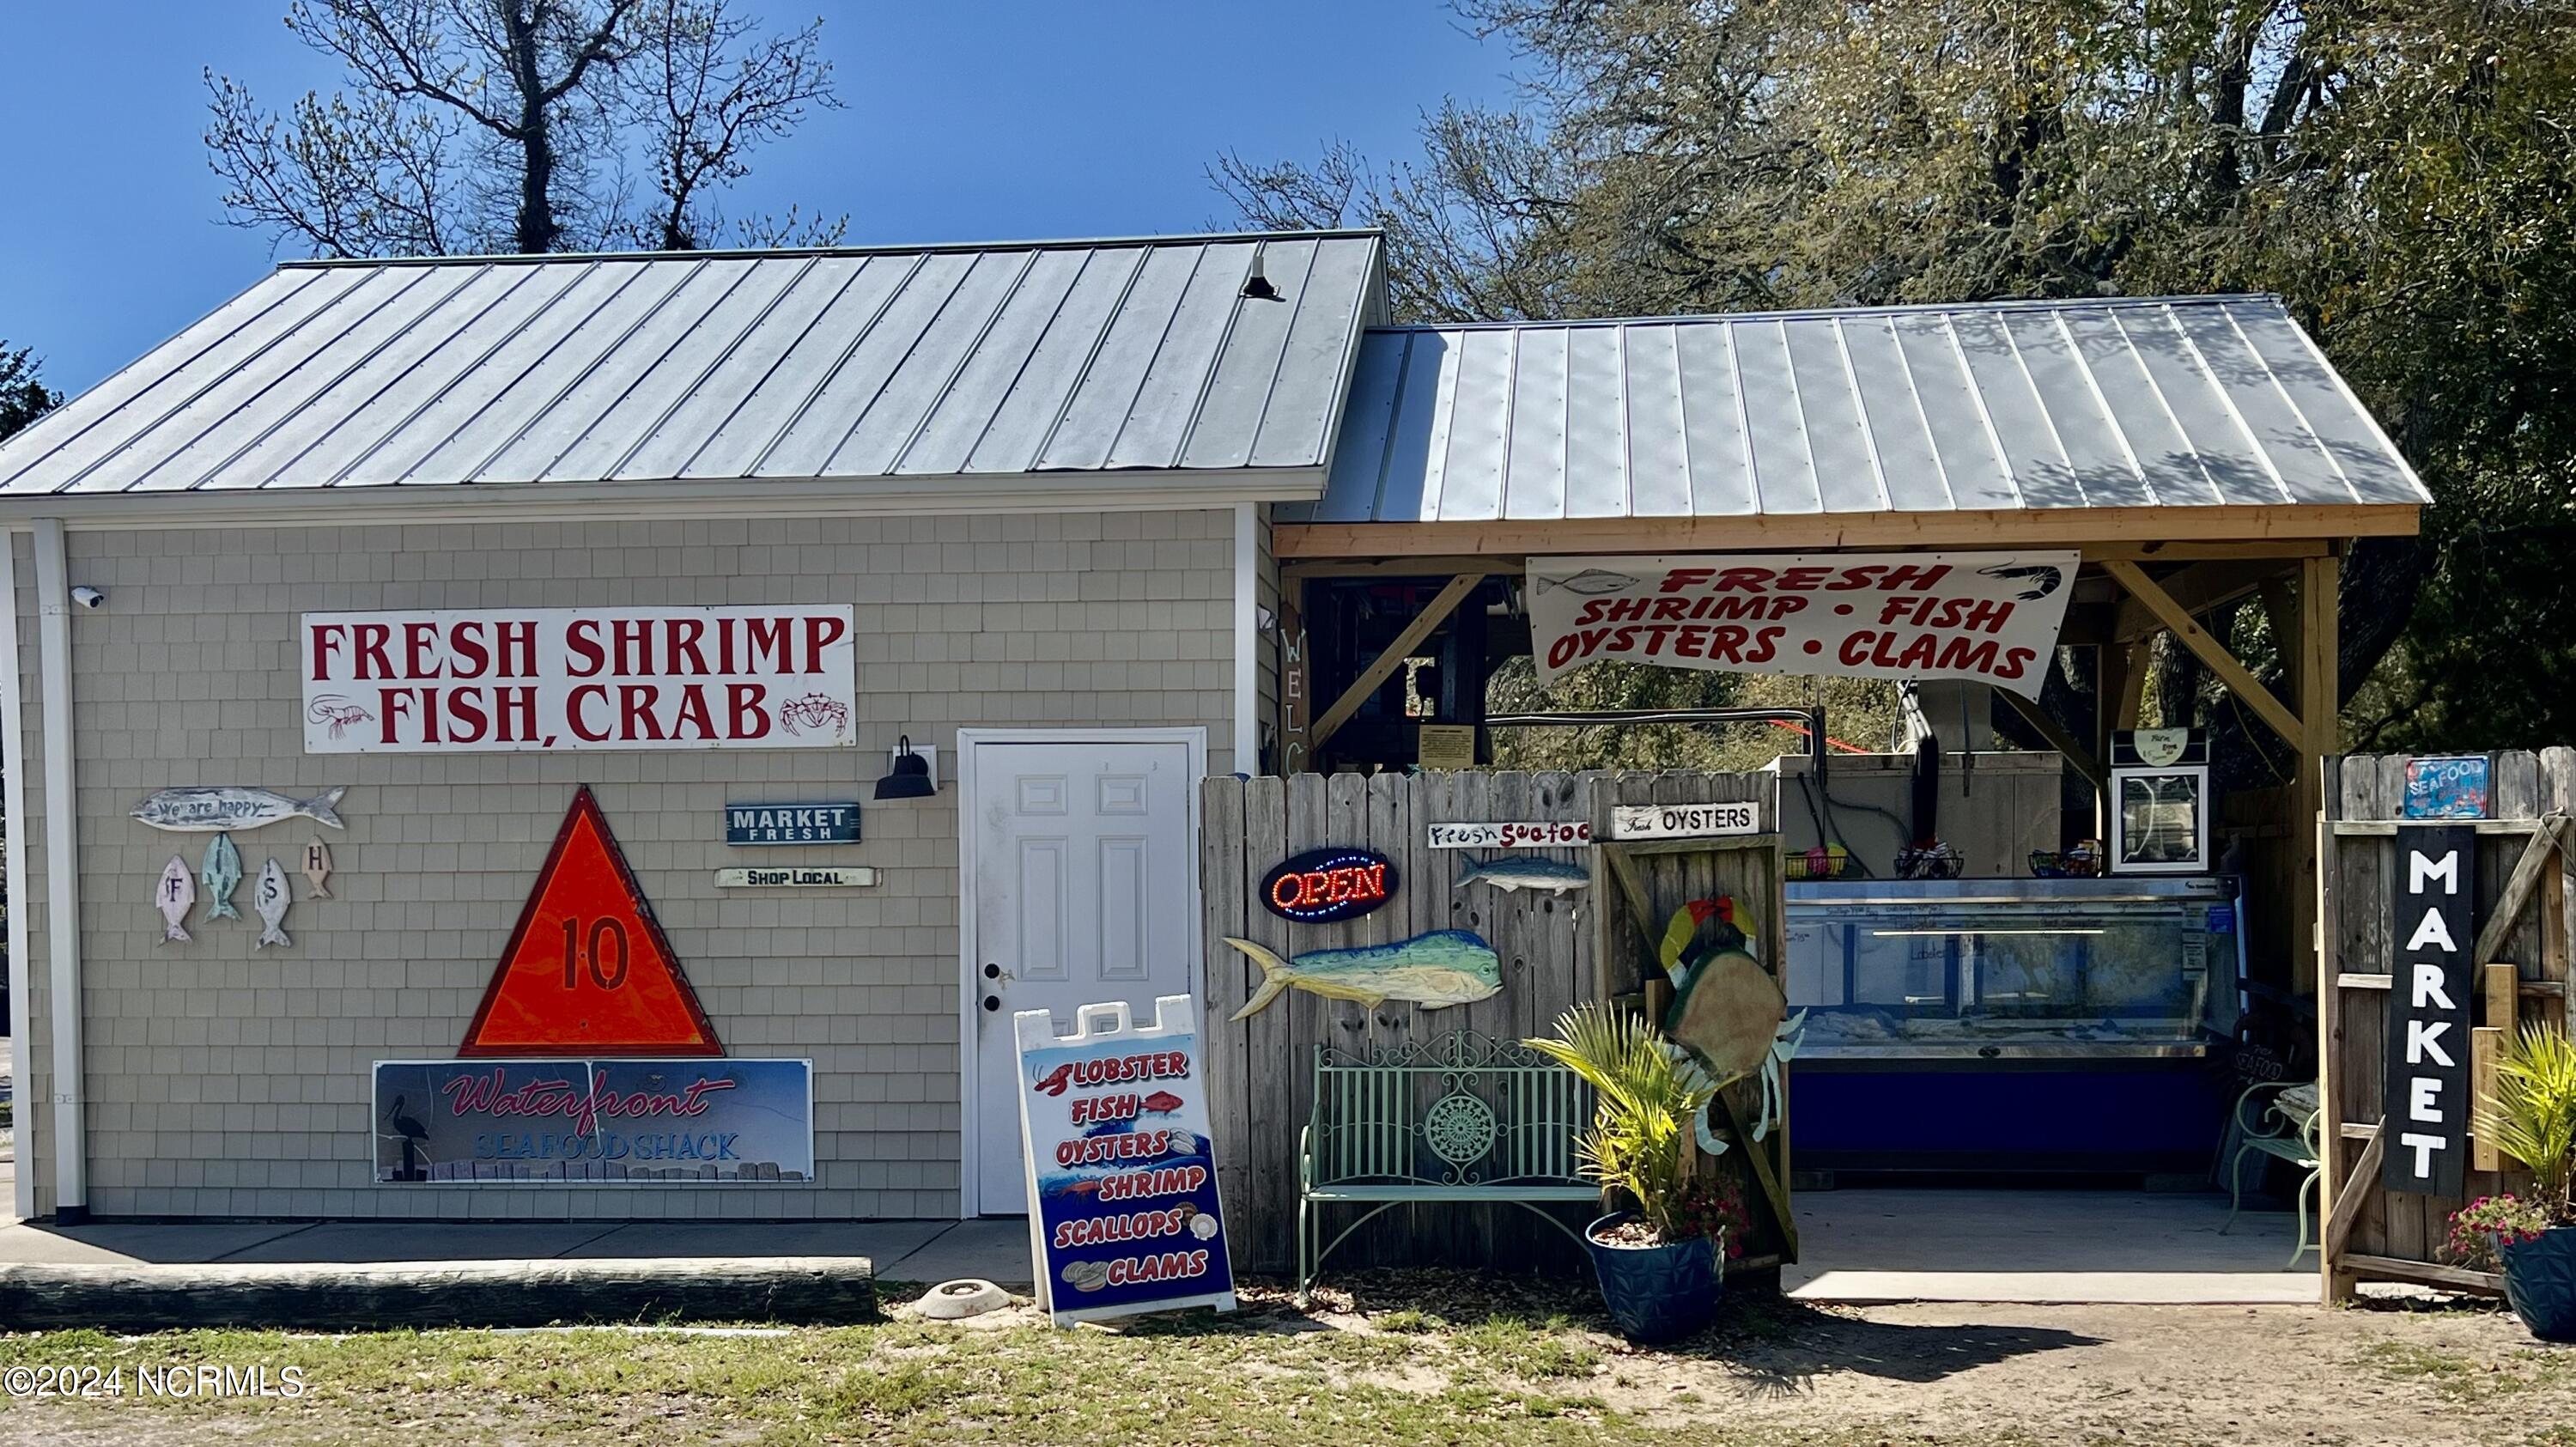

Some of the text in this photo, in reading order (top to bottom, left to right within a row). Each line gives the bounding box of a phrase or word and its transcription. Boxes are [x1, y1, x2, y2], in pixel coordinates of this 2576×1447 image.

[1659, 564, 1953, 593] FRESH
[1575, 596, 2015, 634] SHRIMP FISH
[310, 617, 846, 681] FRESH SHRIMP
[1547, 625, 2037, 679] OYSTERS CLAMS
[379, 683, 771, 747] FISH, CRAB
[2409, 761, 2482, 795] SEAFOOD
[158, 799, 263, 817] We are happy
[733, 809, 845, 829] MARKET
[1624, 808, 1751, 833] Fresh OYSTERS
[749, 828, 831, 841] FRESH
[1431, 825, 1498, 846] Fresh
[1272, 864, 1386, 908] OPEN
[562, 915, 629, 990] 10
[2401, 849, 2458, 1178] MARKET
[1073, 1050, 1188, 1085] LOBSTER
[442, 1068, 736, 1138] Waterfront
[1072, 1092, 1138, 1122] FISH
[475, 1133, 741, 1159] SEAFOOD SHACK
[1055, 1129, 1169, 1164] OYSTERS
[1099, 1166, 1206, 1201] SHRIMP
[1054, 1208, 1184, 1248] SCALLOPS
[1107, 1249, 1208, 1285] CLAMS
